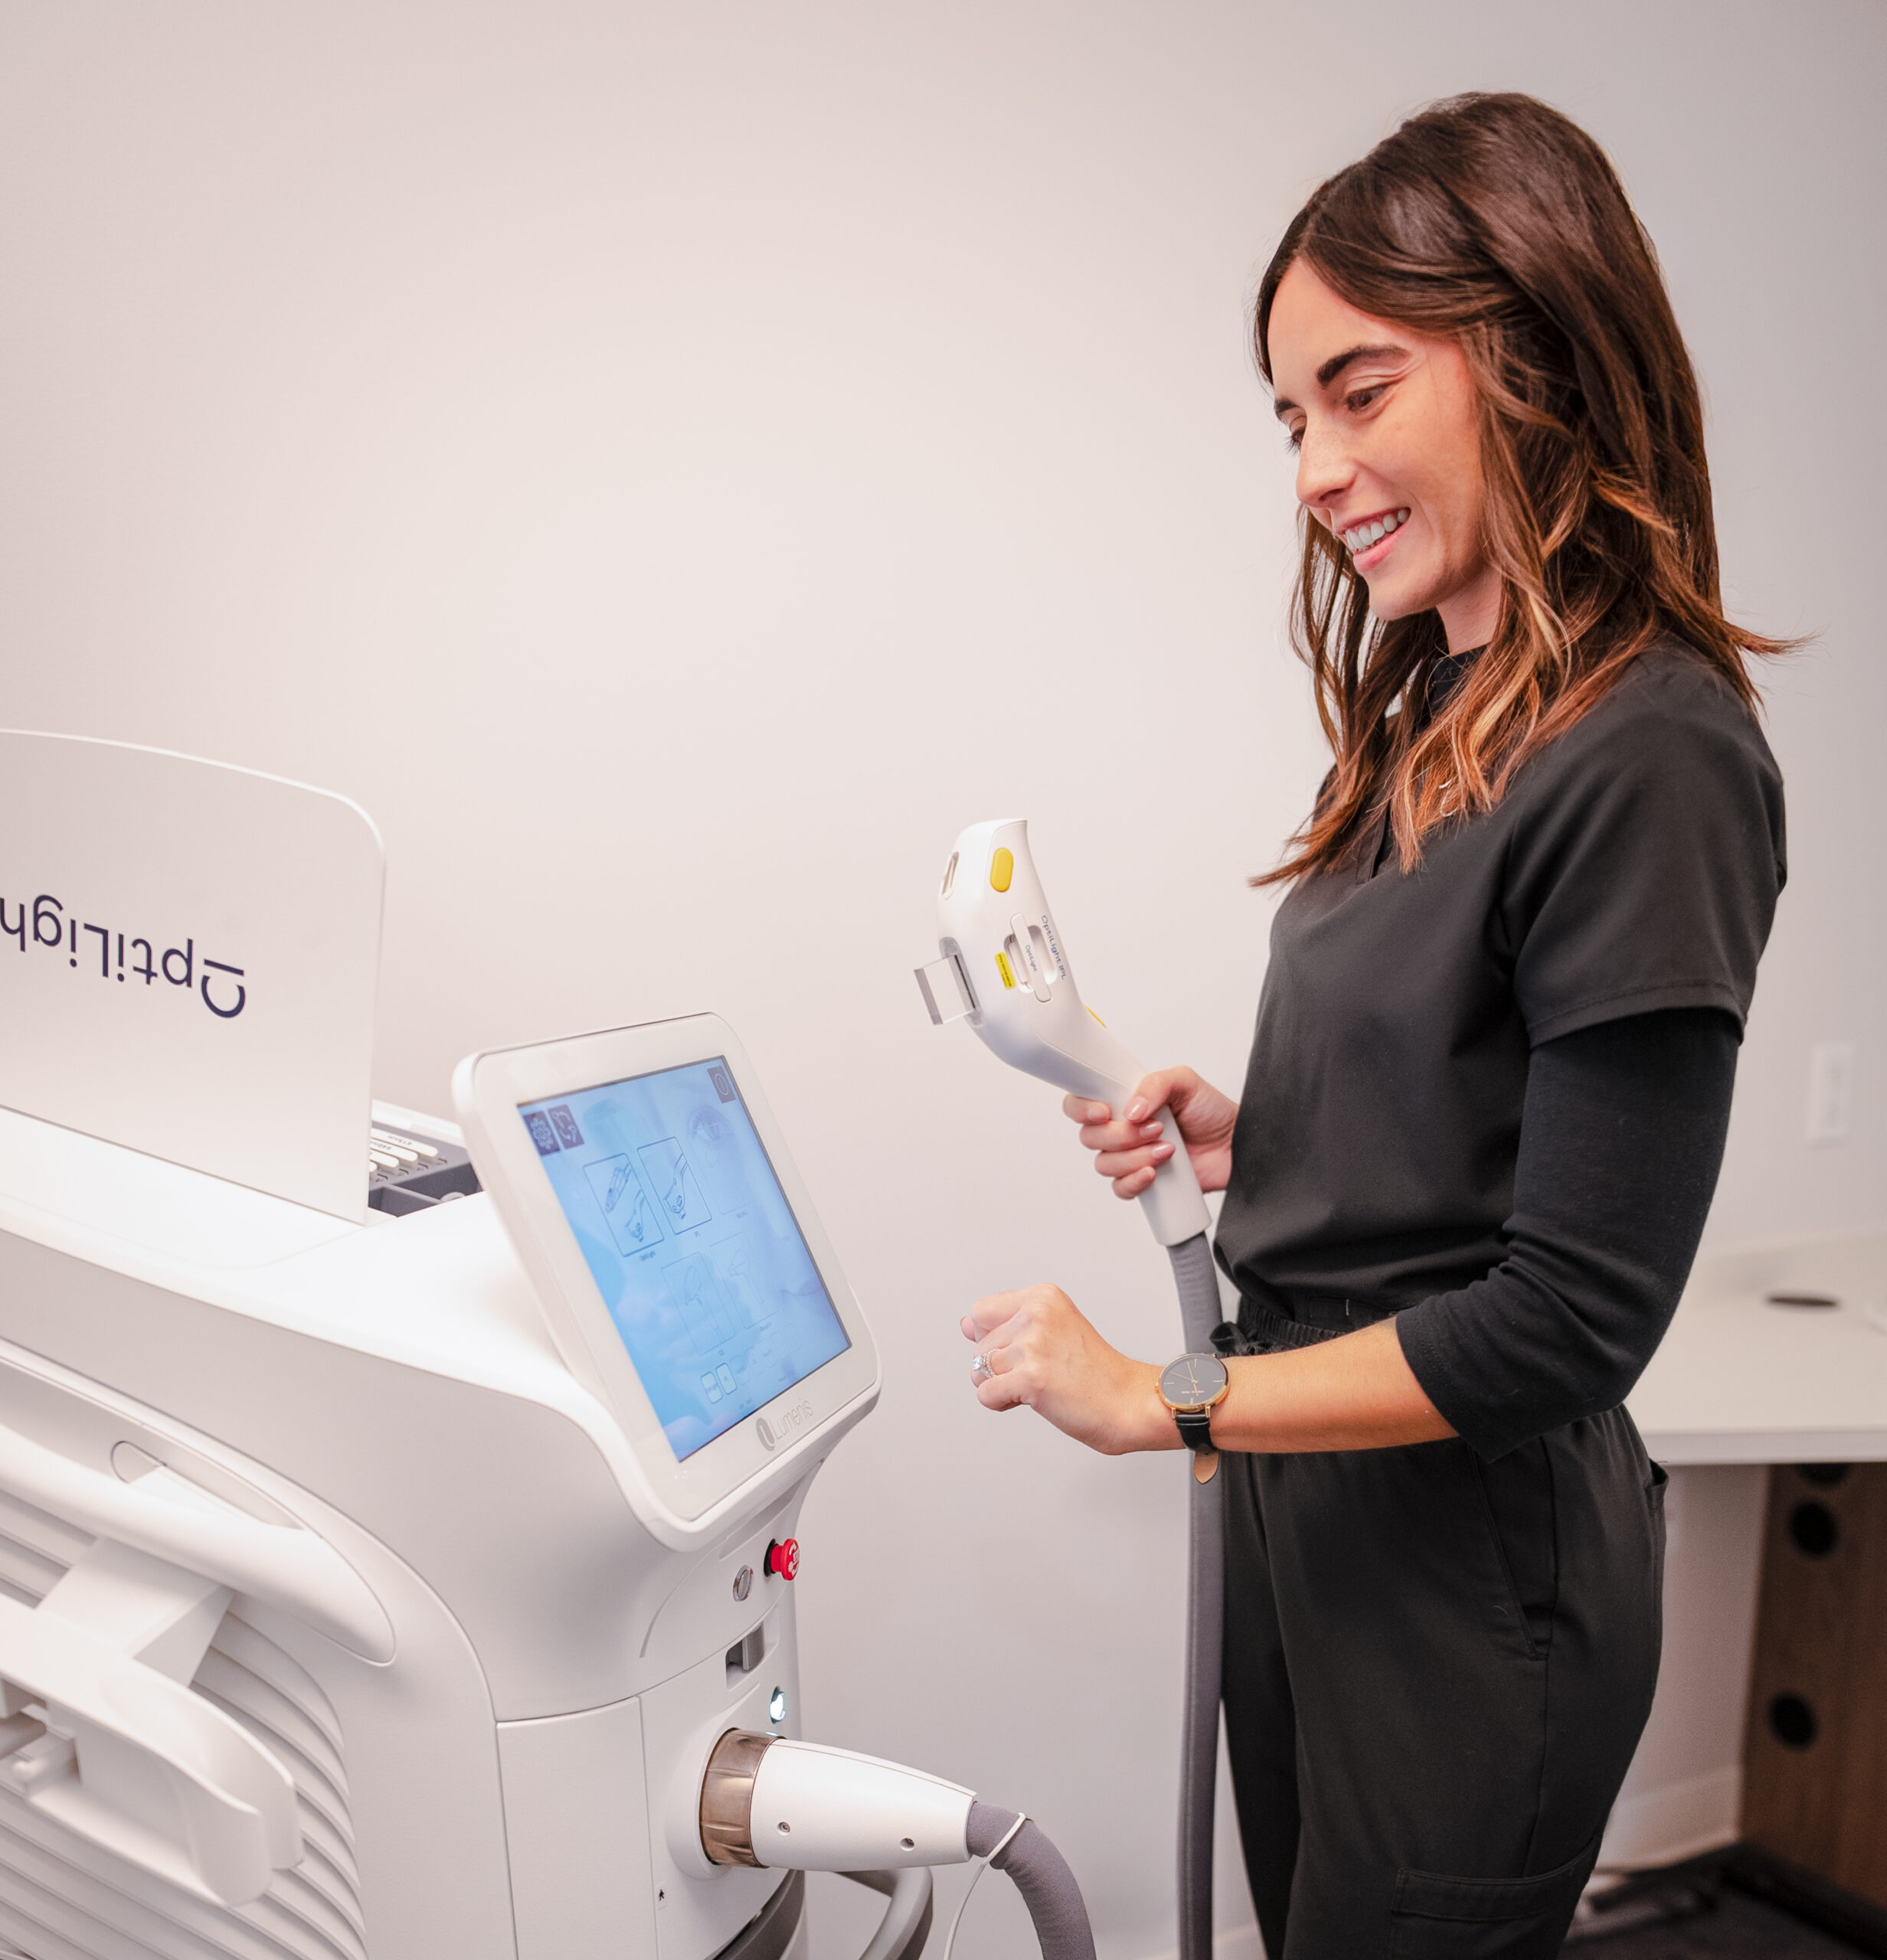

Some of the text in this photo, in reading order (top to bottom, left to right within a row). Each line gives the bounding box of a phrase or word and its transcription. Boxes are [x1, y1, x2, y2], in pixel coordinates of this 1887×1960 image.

[1041, 915, 1067, 980] OptiLight IPL
[768, 1397, 813, 1440] Lumenis
